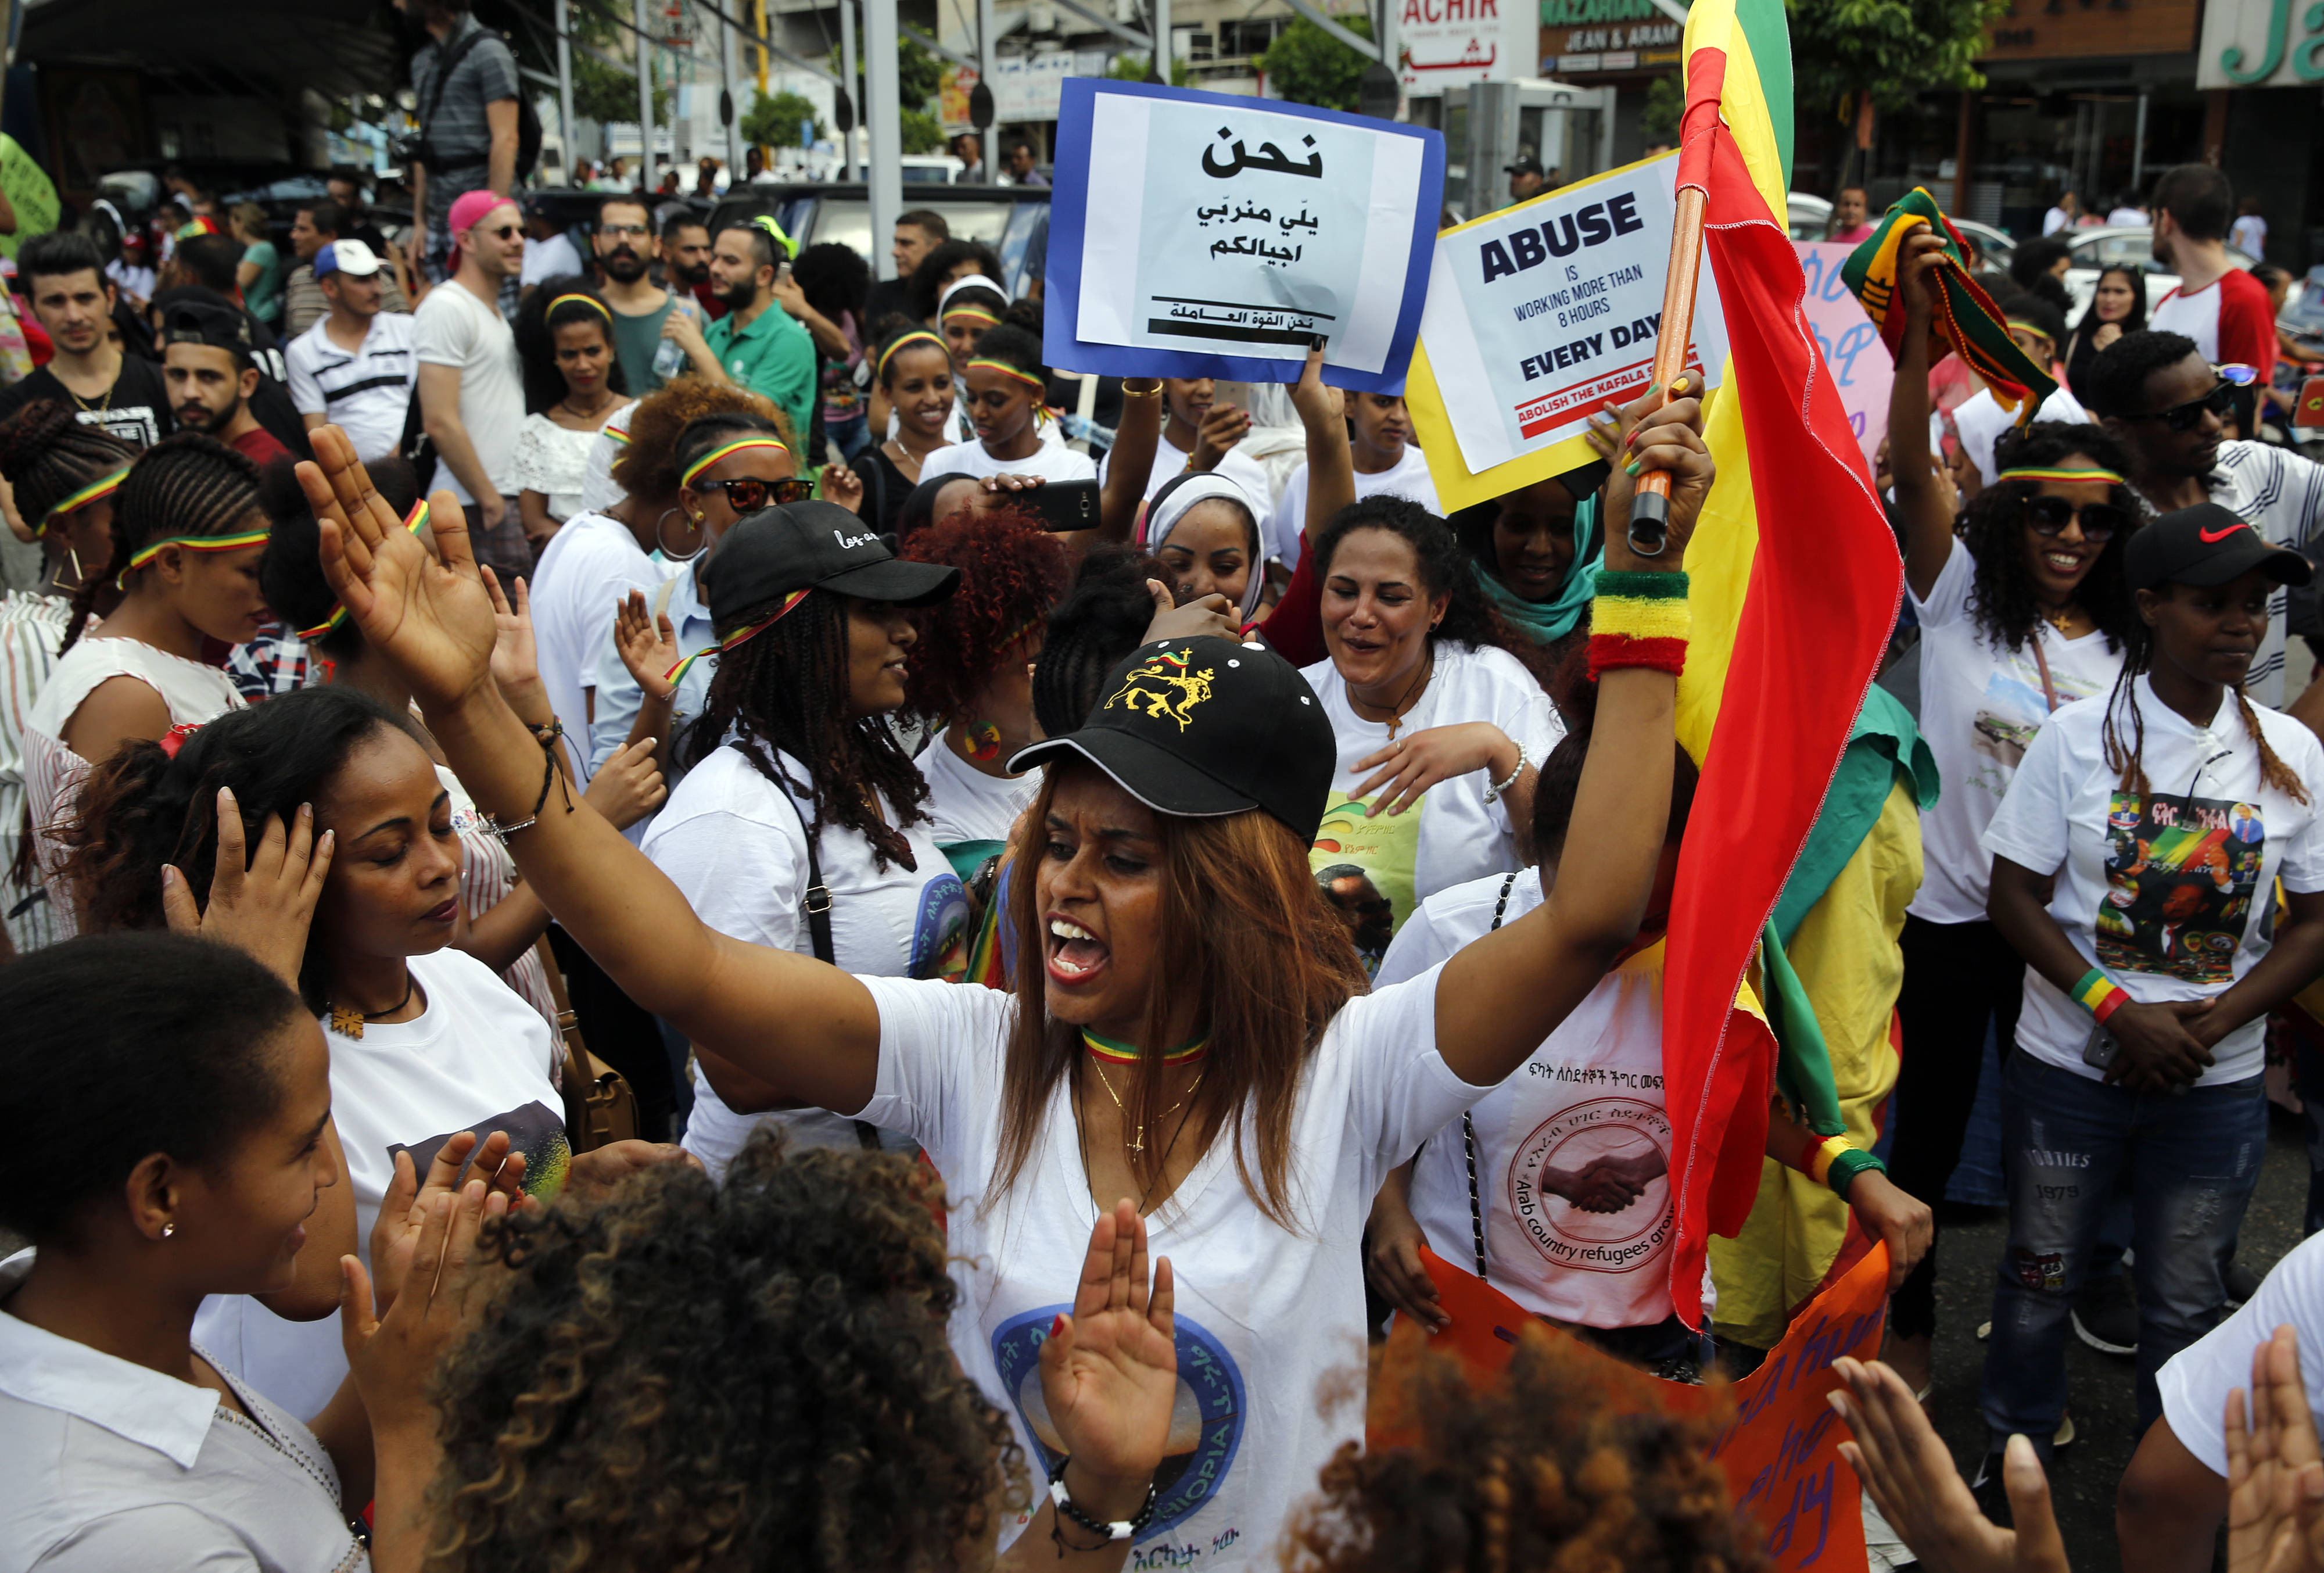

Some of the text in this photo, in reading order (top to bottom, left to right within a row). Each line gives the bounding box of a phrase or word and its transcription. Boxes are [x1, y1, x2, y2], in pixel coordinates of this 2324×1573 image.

[1403, 0, 1497, 23] ACHIR
[1565, 23, 1679, 52] JEAN & ARAM
[1202, 126, 1322, 178] نحن
[1210, 236, 1302, 267] اجيالكم
[1480, 191, 1644, 284] ABUSE
[1565, 265, 1578, 282] IS
[1514, 264, 1643, 321] WORKING MORE THAN
[1253, 312, 1283, 328] القوة
[1287, 316, 1313, 331] نحن
[1558, 298, 1610, 327] 8 HOURS
[1520, 332, 1603, 381] EVERY
[1610, 312, 1661, 349] DAY
[1518, 370, 1645, 423] ABOLISH THE KAFALA
[1529, 1063, 1554, 1078] ፍካት
[1610, 1070, 1637, 1089] ችግር
[1516, 1180, 1536, 1216] Arab
[1527, 1218, 1579, 1260] country
[1580, 1241, 1650, 1265] refugees
[1153, 1424, 1229, 1521] HIOPIA
